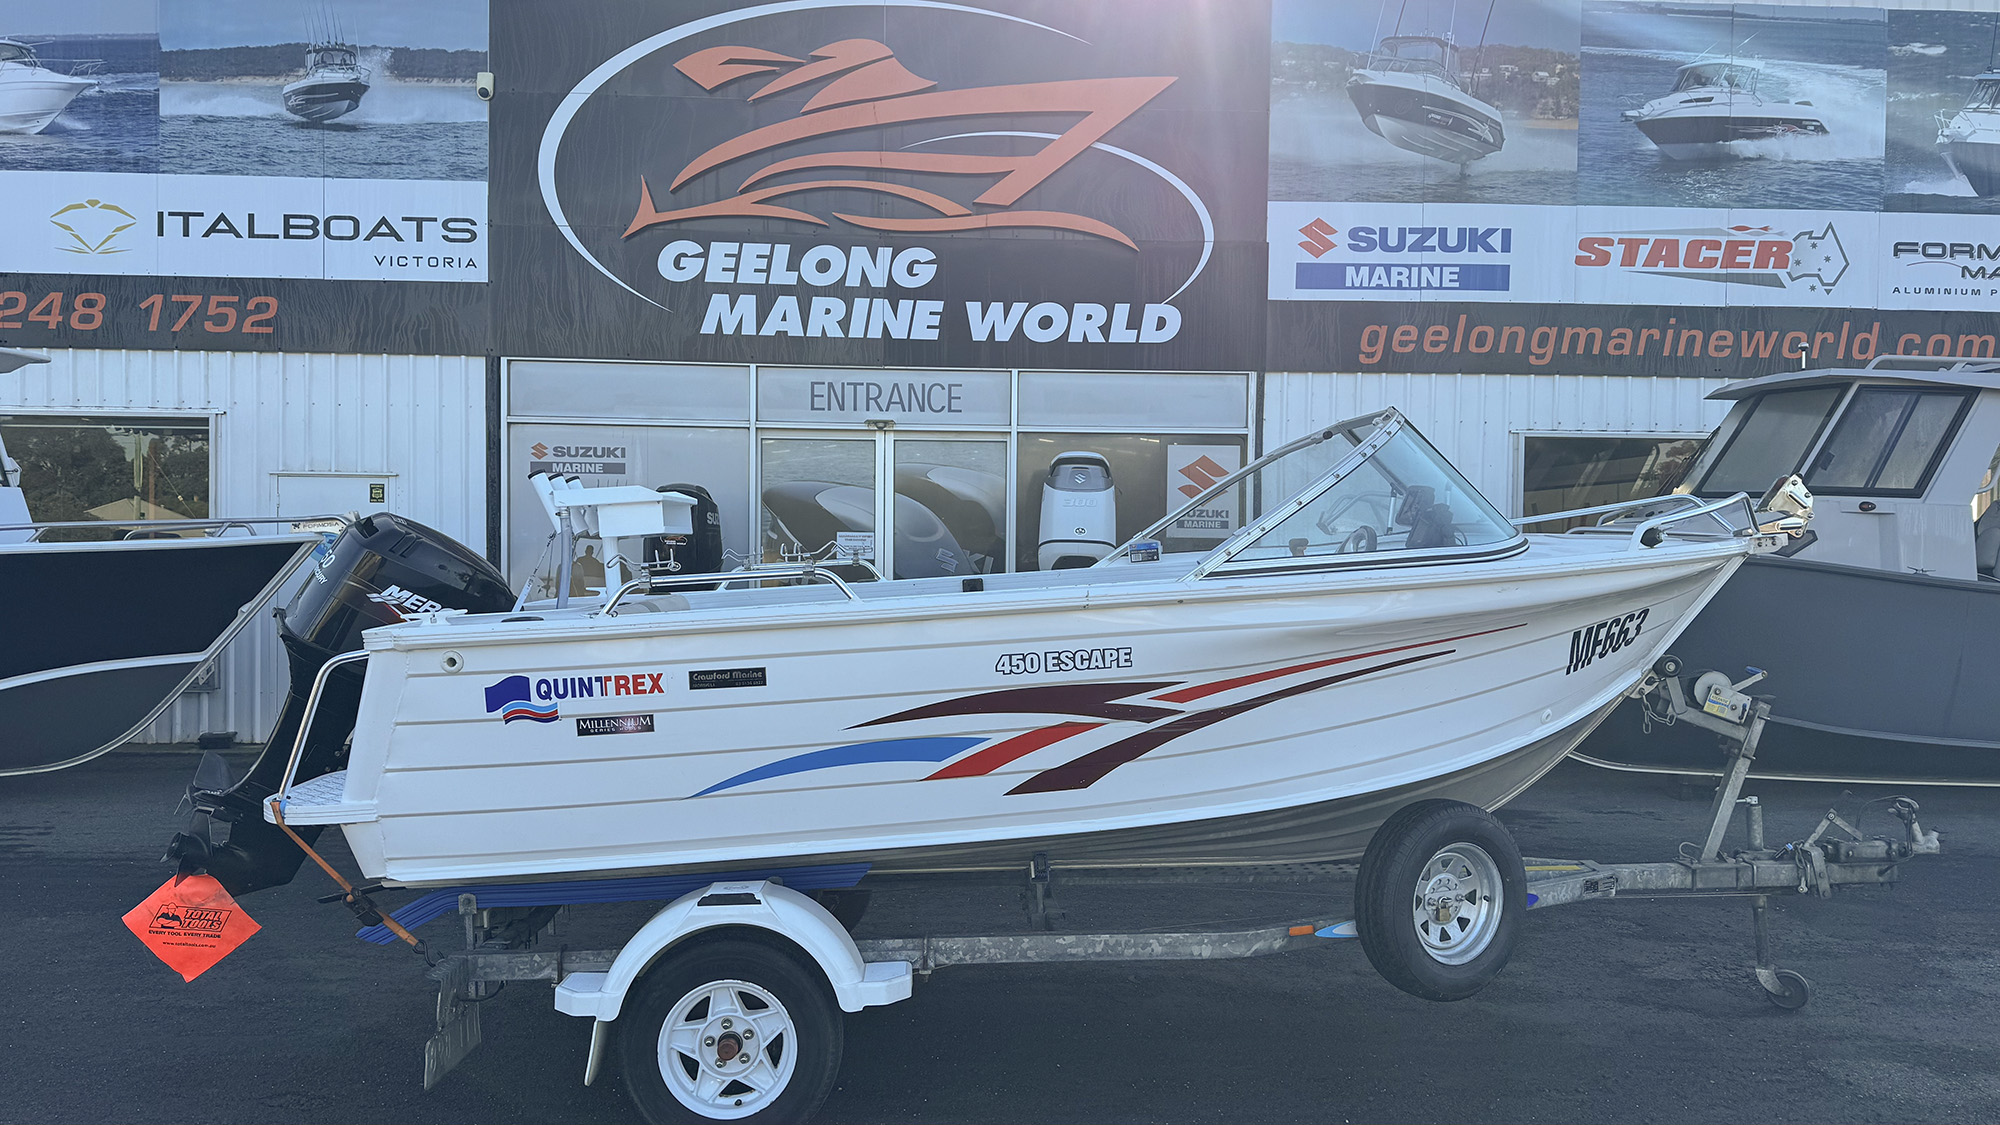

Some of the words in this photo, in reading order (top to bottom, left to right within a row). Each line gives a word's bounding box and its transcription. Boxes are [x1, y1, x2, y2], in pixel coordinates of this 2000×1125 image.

[157, 211, 478, 243] ITALBOATS
[1347, 226, 1512, 253] SUZUKI
[374, 256, 478, 269] VICTORIA
[657, 240, 938, 288] GEELONG
[1575, 237, 1793, 269] STACER
[1345, 266, 1460, 288] MARINE
[1892, 287, 1981, 296] ALUMINIUM
[0, 291, 106, 330] 248
[139, 294, 279, 334] 1752
[700, 294, 945, 341] MARINE
[965, 301, 1182, 344] WORLD
[1358, 314, 1995, 365] geelongmarineworld.com
[810, 381, 963, 413] ENTRANCE
[553, 446, 626, 458] SUZUKI
[552, 462, 604, 473] MARINE
[1183, 509, 1229, 518] UZUKI
[1565, 608, 1650, 676] MF663
[995, 653, 1040, 675] 450
[1044, 647, 1133, 672] ESCAPE
[536, 673, 665, 700] QUINTREX
[692, 672, 730, 680] Crawford
[732, 670, 763, 679] Marine
[579, 716, 651, 730] MILLENNIUM
[181, 919, 222, 931] TOOLS
[185, 909, 223, 920] TOTAL
